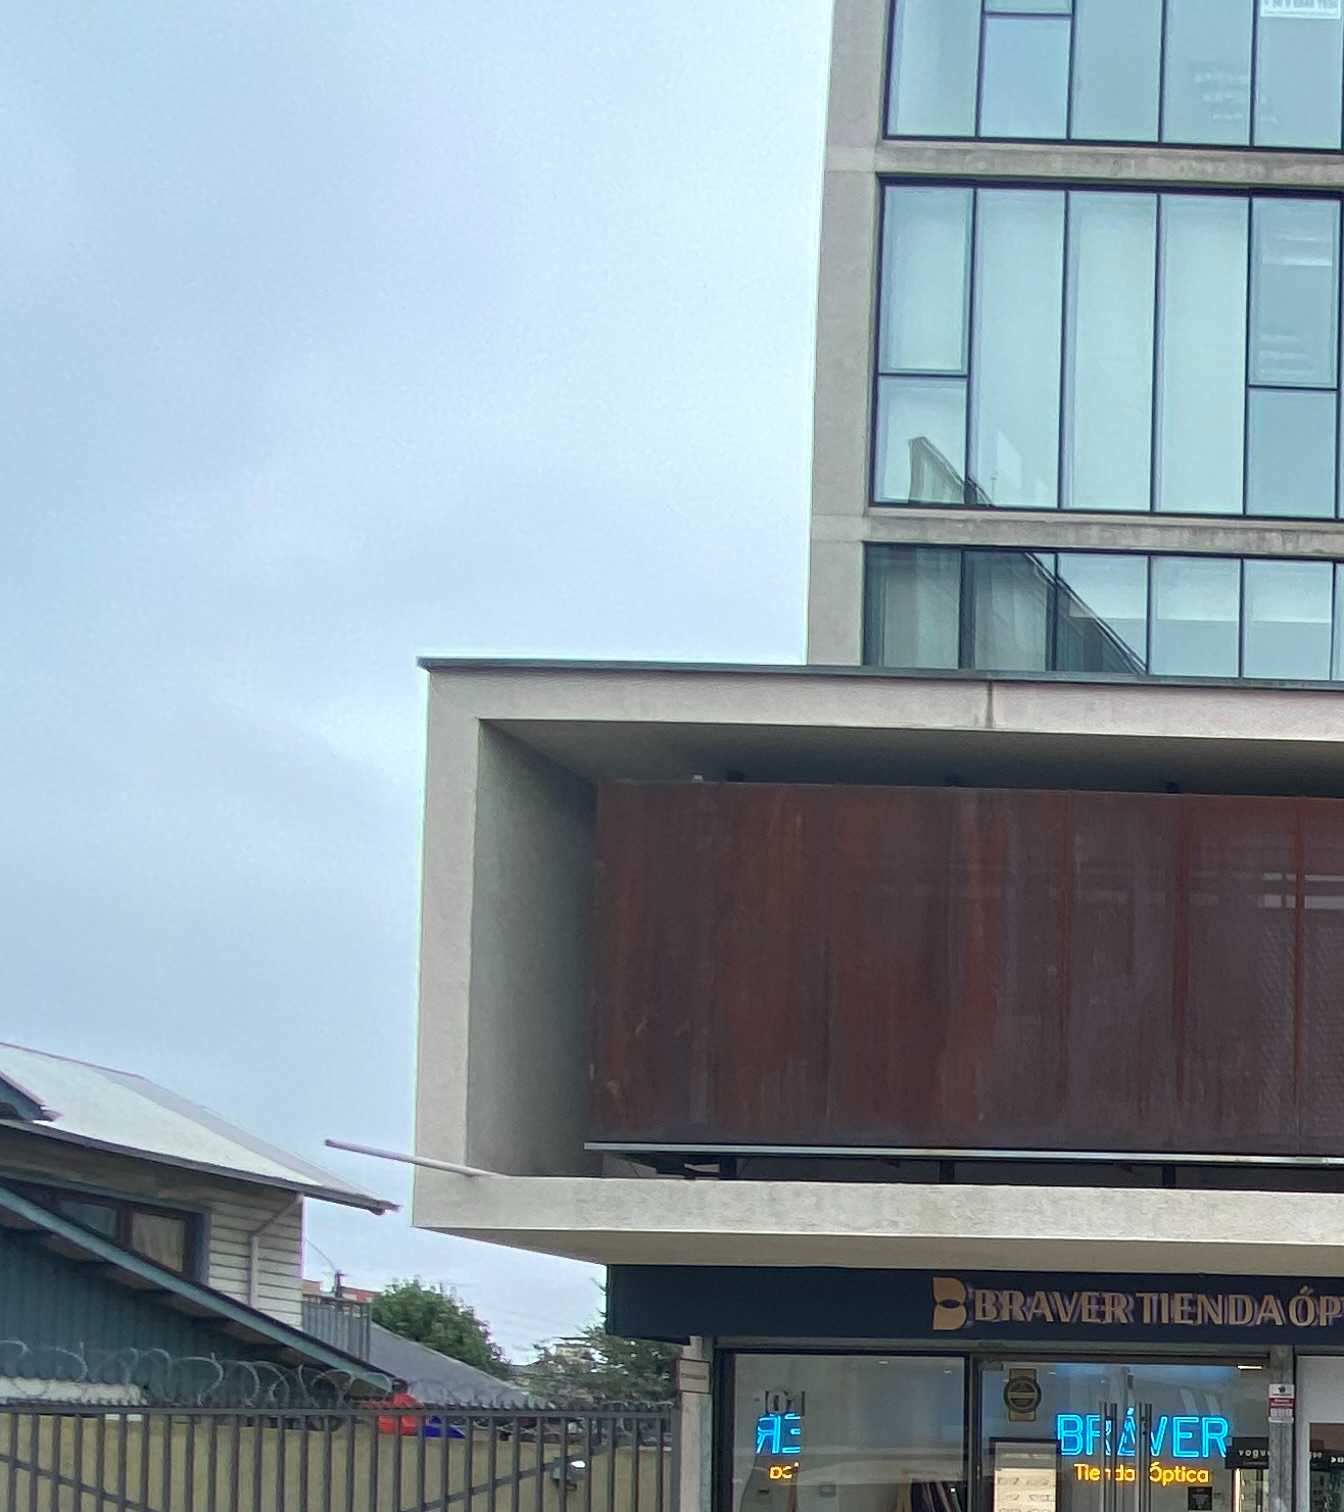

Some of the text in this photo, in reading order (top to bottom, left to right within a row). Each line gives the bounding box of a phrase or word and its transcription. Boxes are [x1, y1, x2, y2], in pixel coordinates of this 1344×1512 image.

[972, 1287, 1131, 1324] BRAVER
[1135, 1291, 1286, 1328] TIENDA
[1149, 1461, 1210, 1487] Óptica
